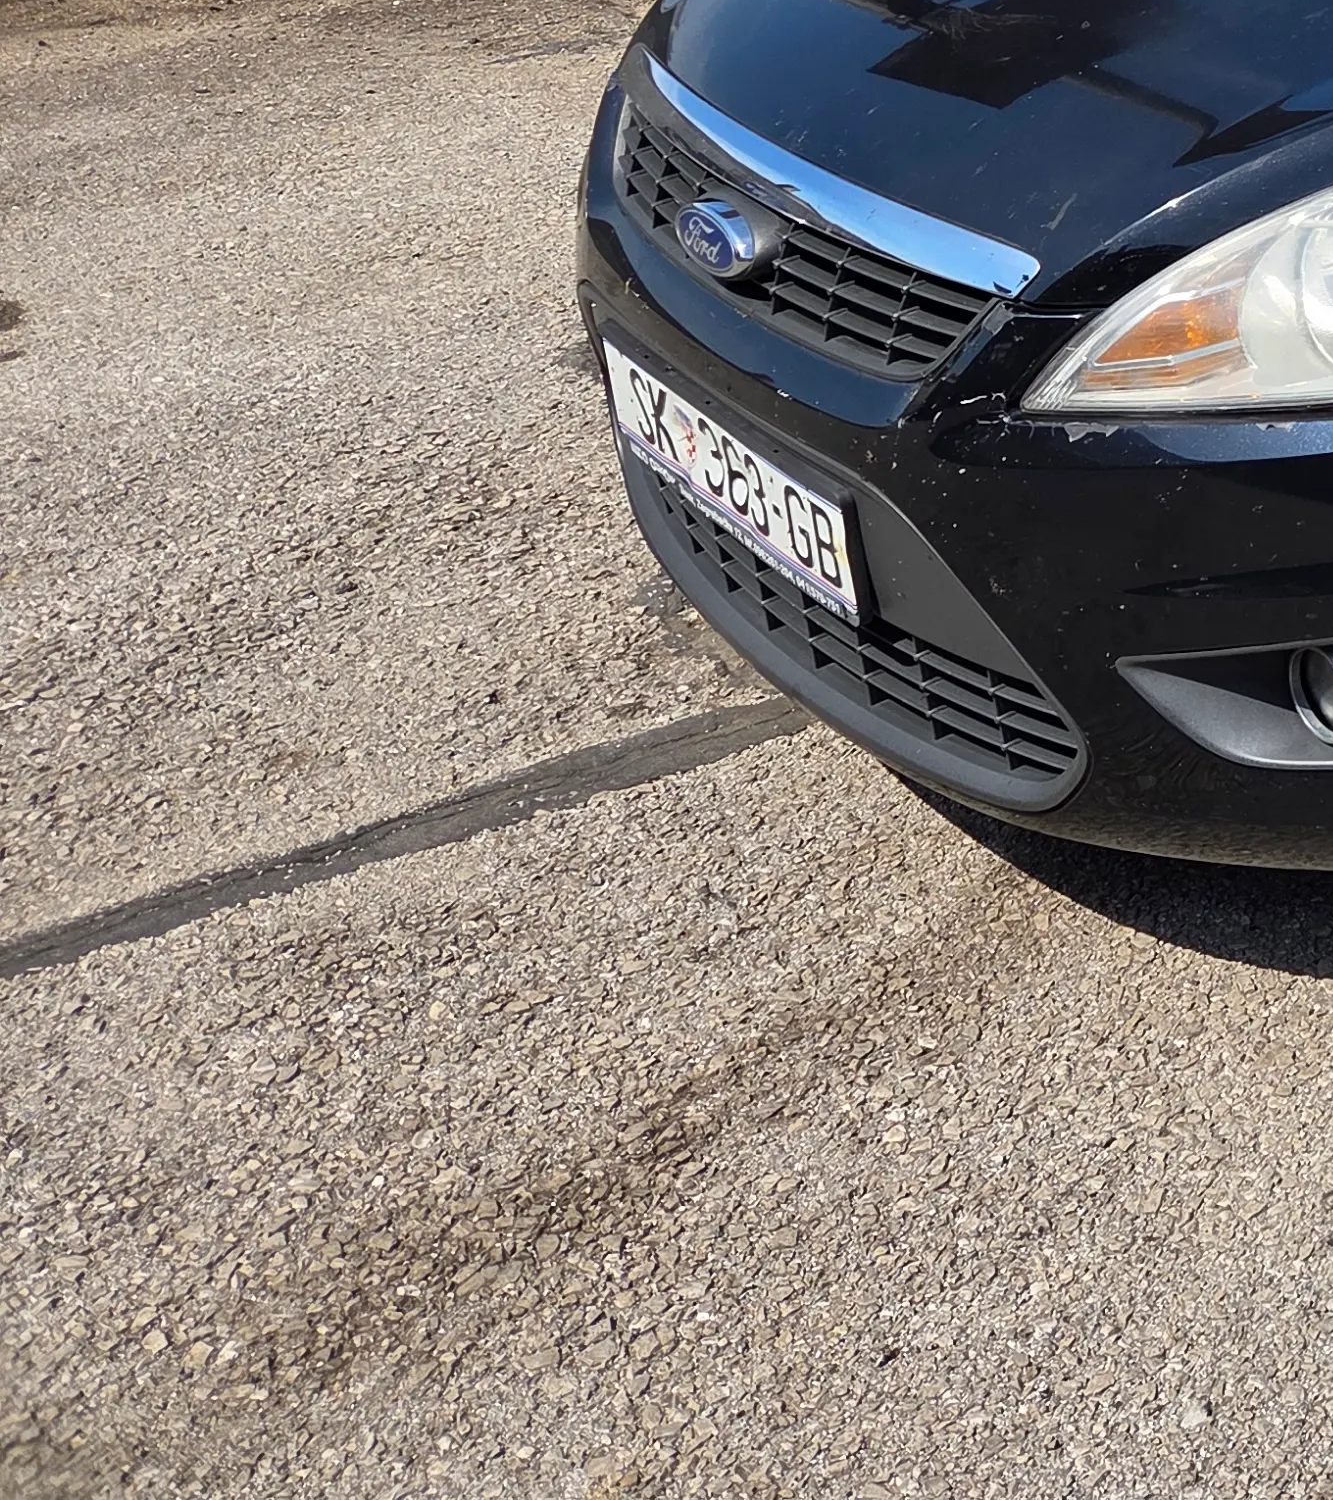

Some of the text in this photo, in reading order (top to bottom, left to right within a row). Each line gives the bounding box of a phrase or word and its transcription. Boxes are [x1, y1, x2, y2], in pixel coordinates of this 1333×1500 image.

[684, 216, 722, 263] Ford
[630, 368, 842, 588] SK 363-GB
